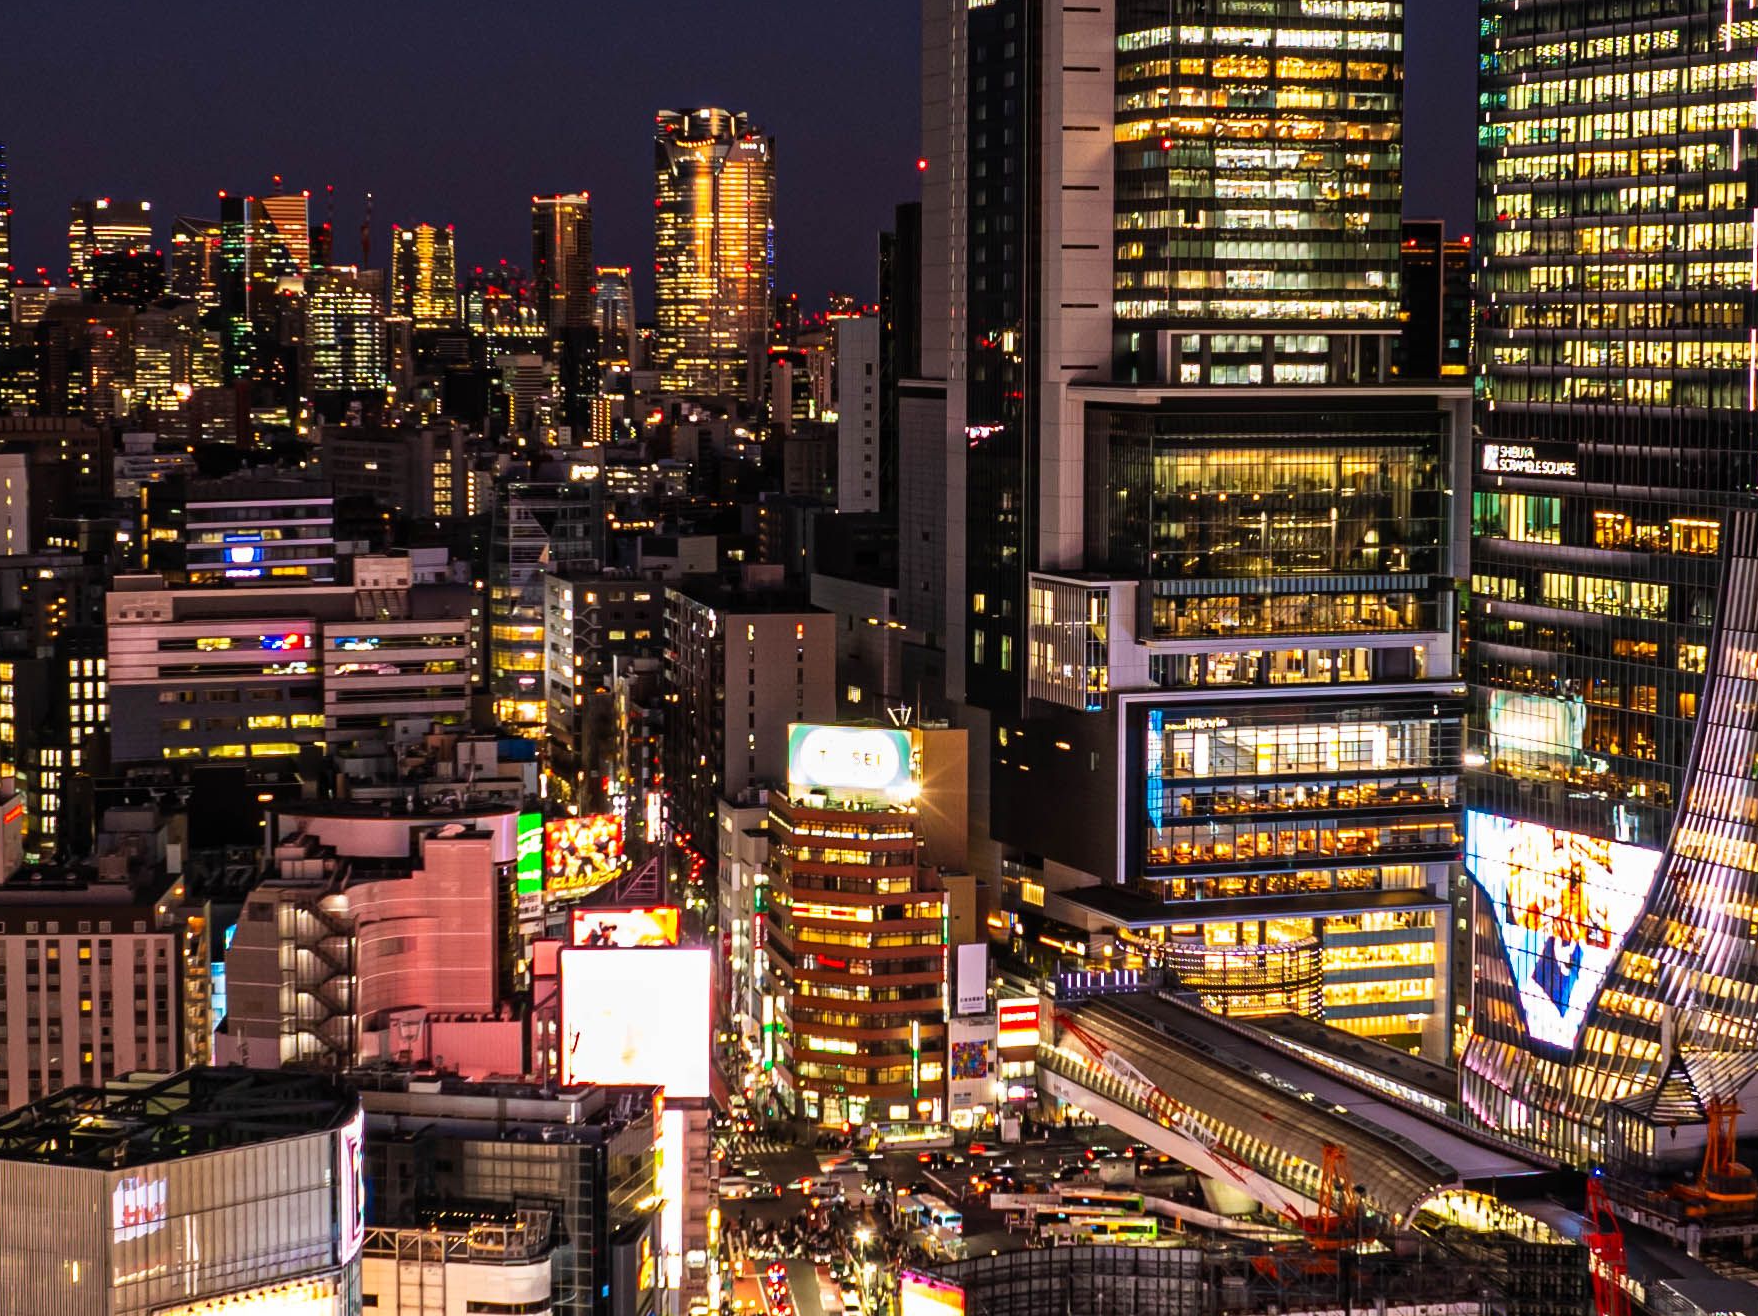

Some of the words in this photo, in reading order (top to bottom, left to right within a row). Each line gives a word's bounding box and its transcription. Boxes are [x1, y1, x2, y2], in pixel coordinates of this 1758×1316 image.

[1499, 445, 1534, 459] SHIBUYA
[1499, 459, 1541, 474] SCRAMBLE
[1541, 461, 1576, 476] SQUARE
[819, 749, 881, 766] TSEI
